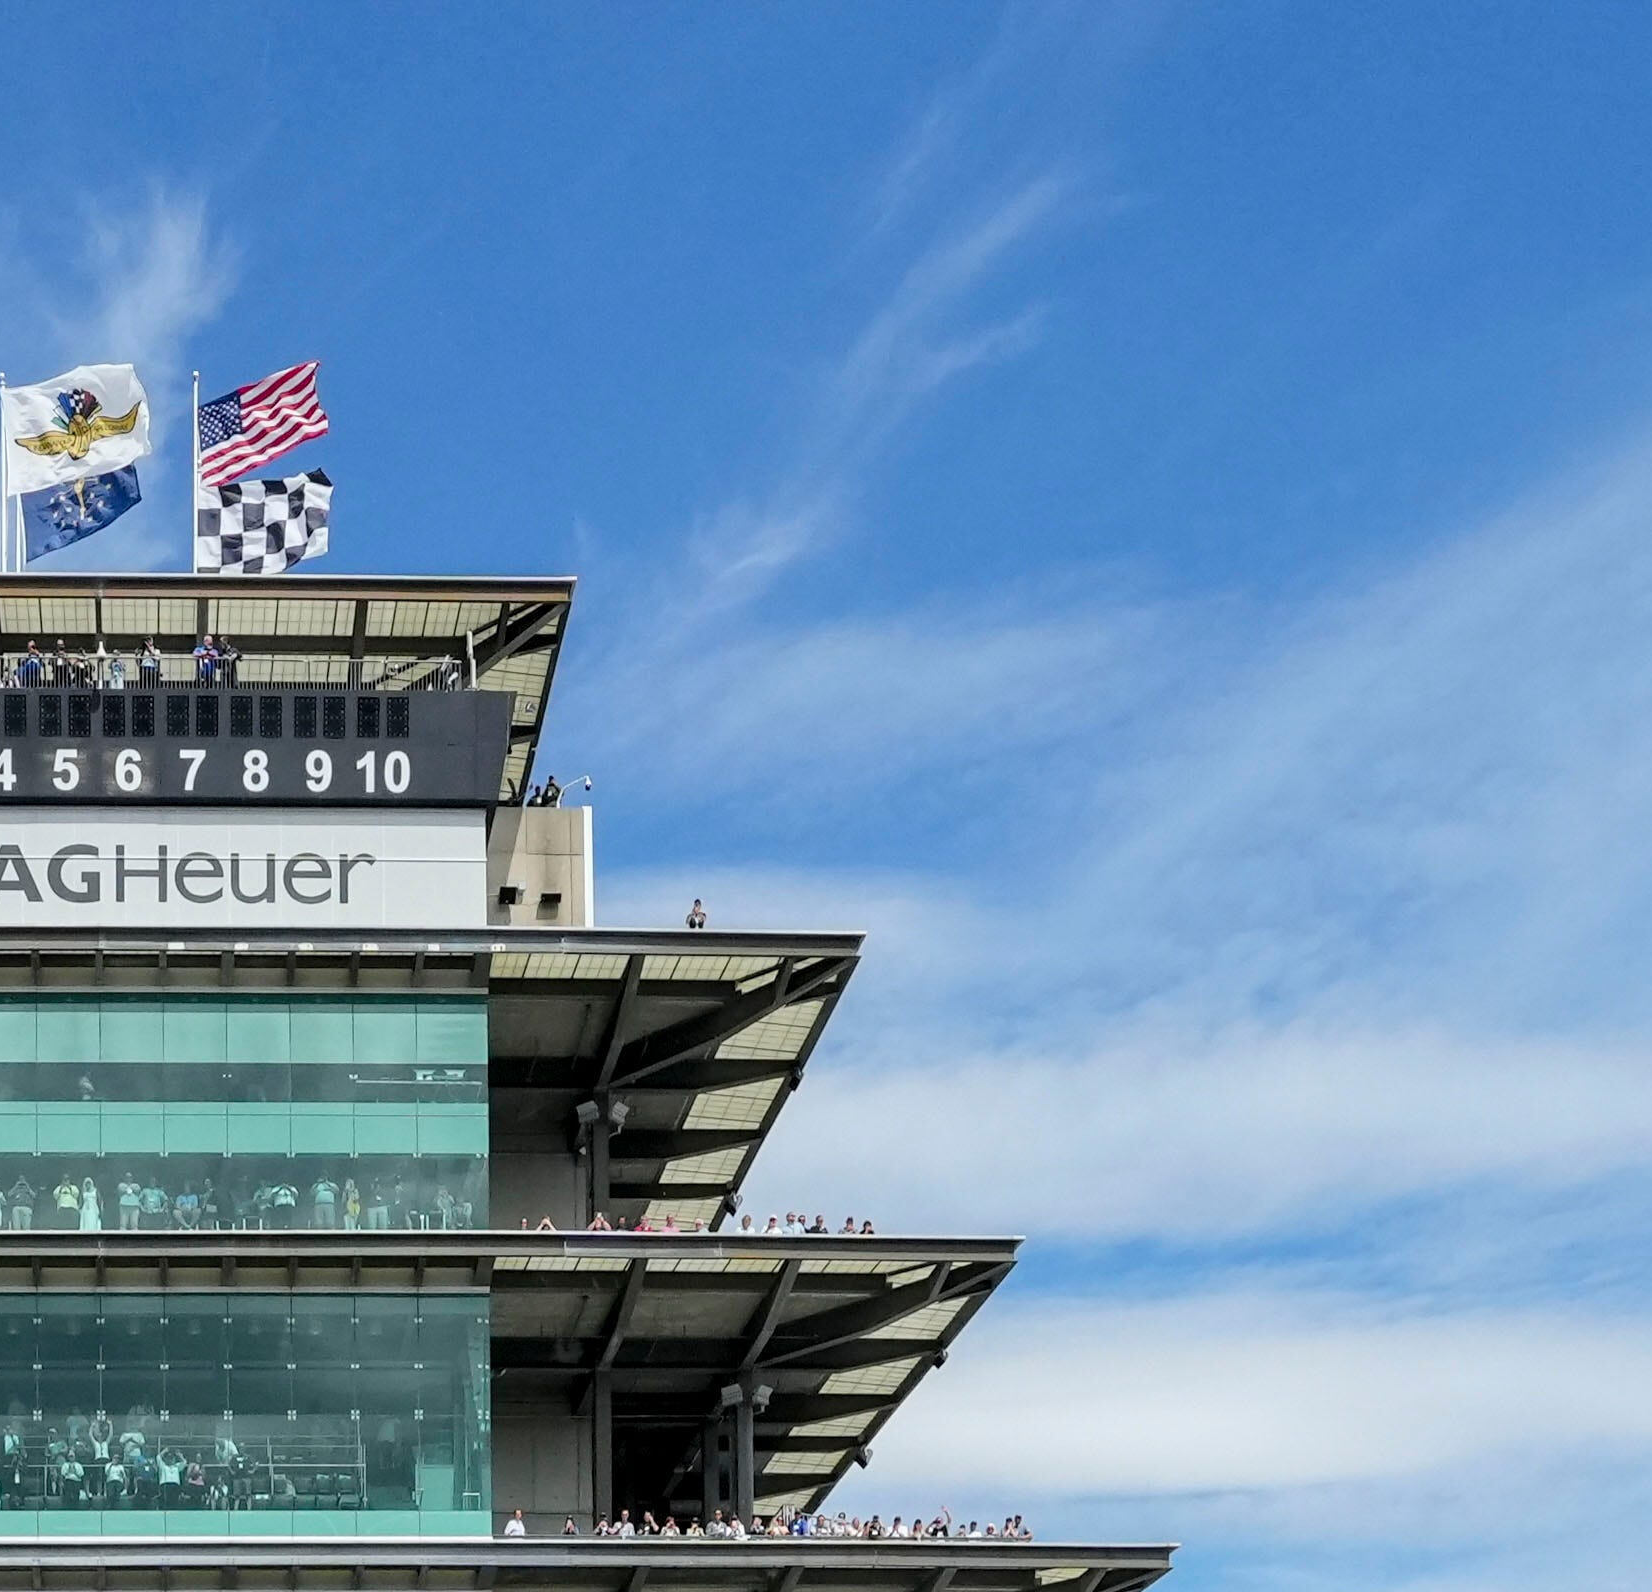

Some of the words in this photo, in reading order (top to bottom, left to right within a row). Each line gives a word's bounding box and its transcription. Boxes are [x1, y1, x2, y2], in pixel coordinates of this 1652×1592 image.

[53, 748, 80, 791] 5
[113, 748, 145, 792] 6
[180, 749, 207, 791] 7
[243, 749, 270, 793] 8
[306, 749, 333, 793] 9
[357, 750, 411, 794] 10
